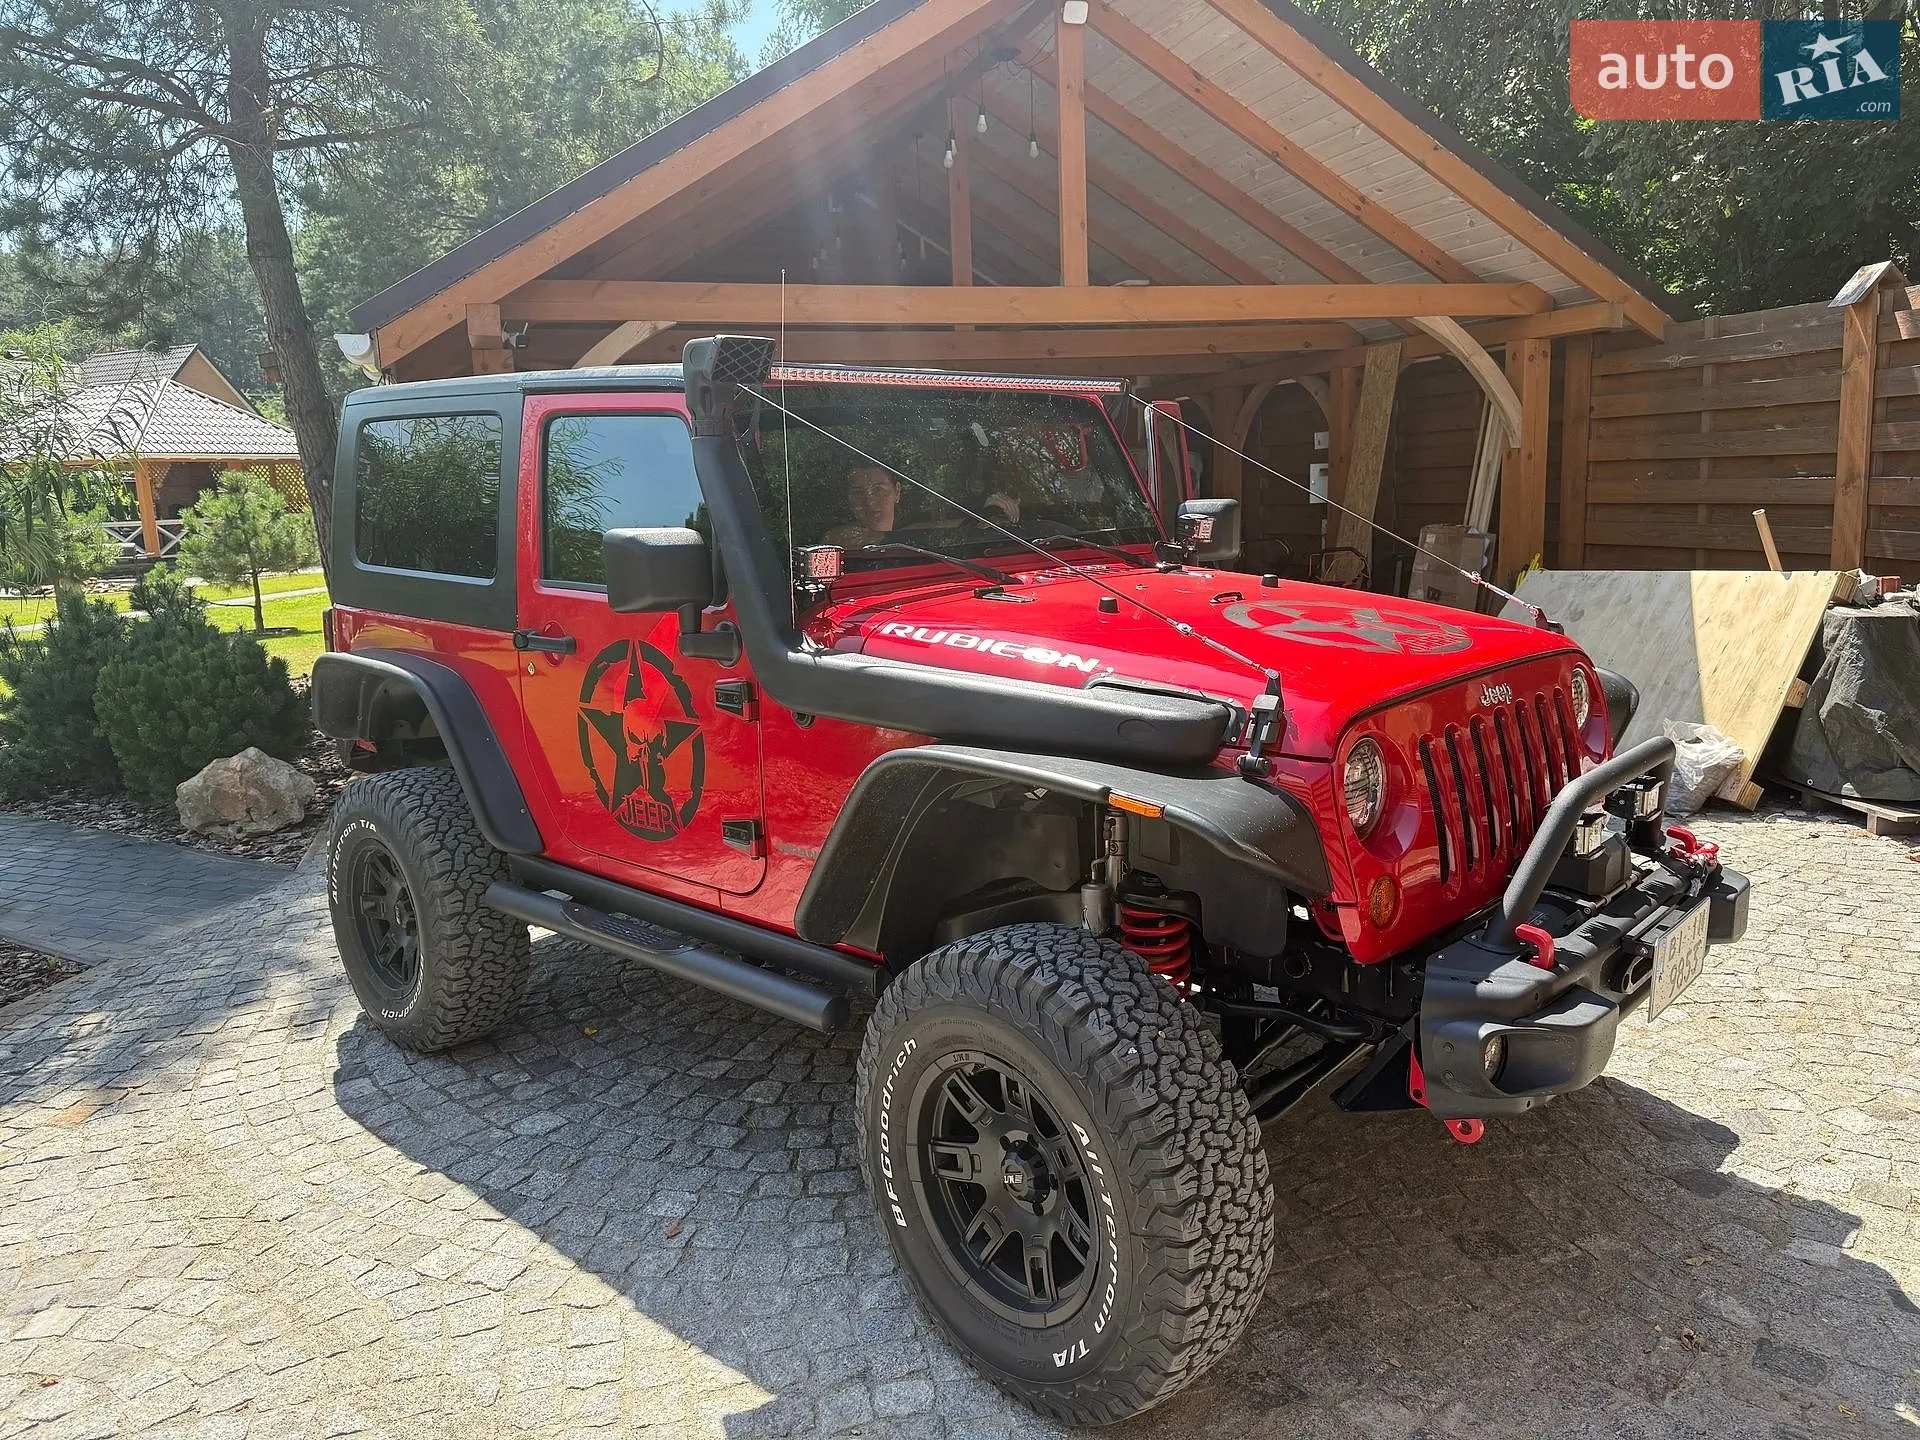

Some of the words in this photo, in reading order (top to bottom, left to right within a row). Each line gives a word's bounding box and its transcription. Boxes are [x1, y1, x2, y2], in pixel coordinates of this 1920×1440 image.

[880, 622, 1101, 674] RUBICON
[1480, 682, 1513, 707] Jeep
[619, 797, 673, 832] JEEP
[331, 822, 357, 905] All-Terrain
[360, 819, 377, 833] T/A
[880, 1037, 918, 1228] BFGoodrich
[1071, 1120, 1117, 1335] All-Terrain
[1052, 1338, 1090, 1368] T/A
